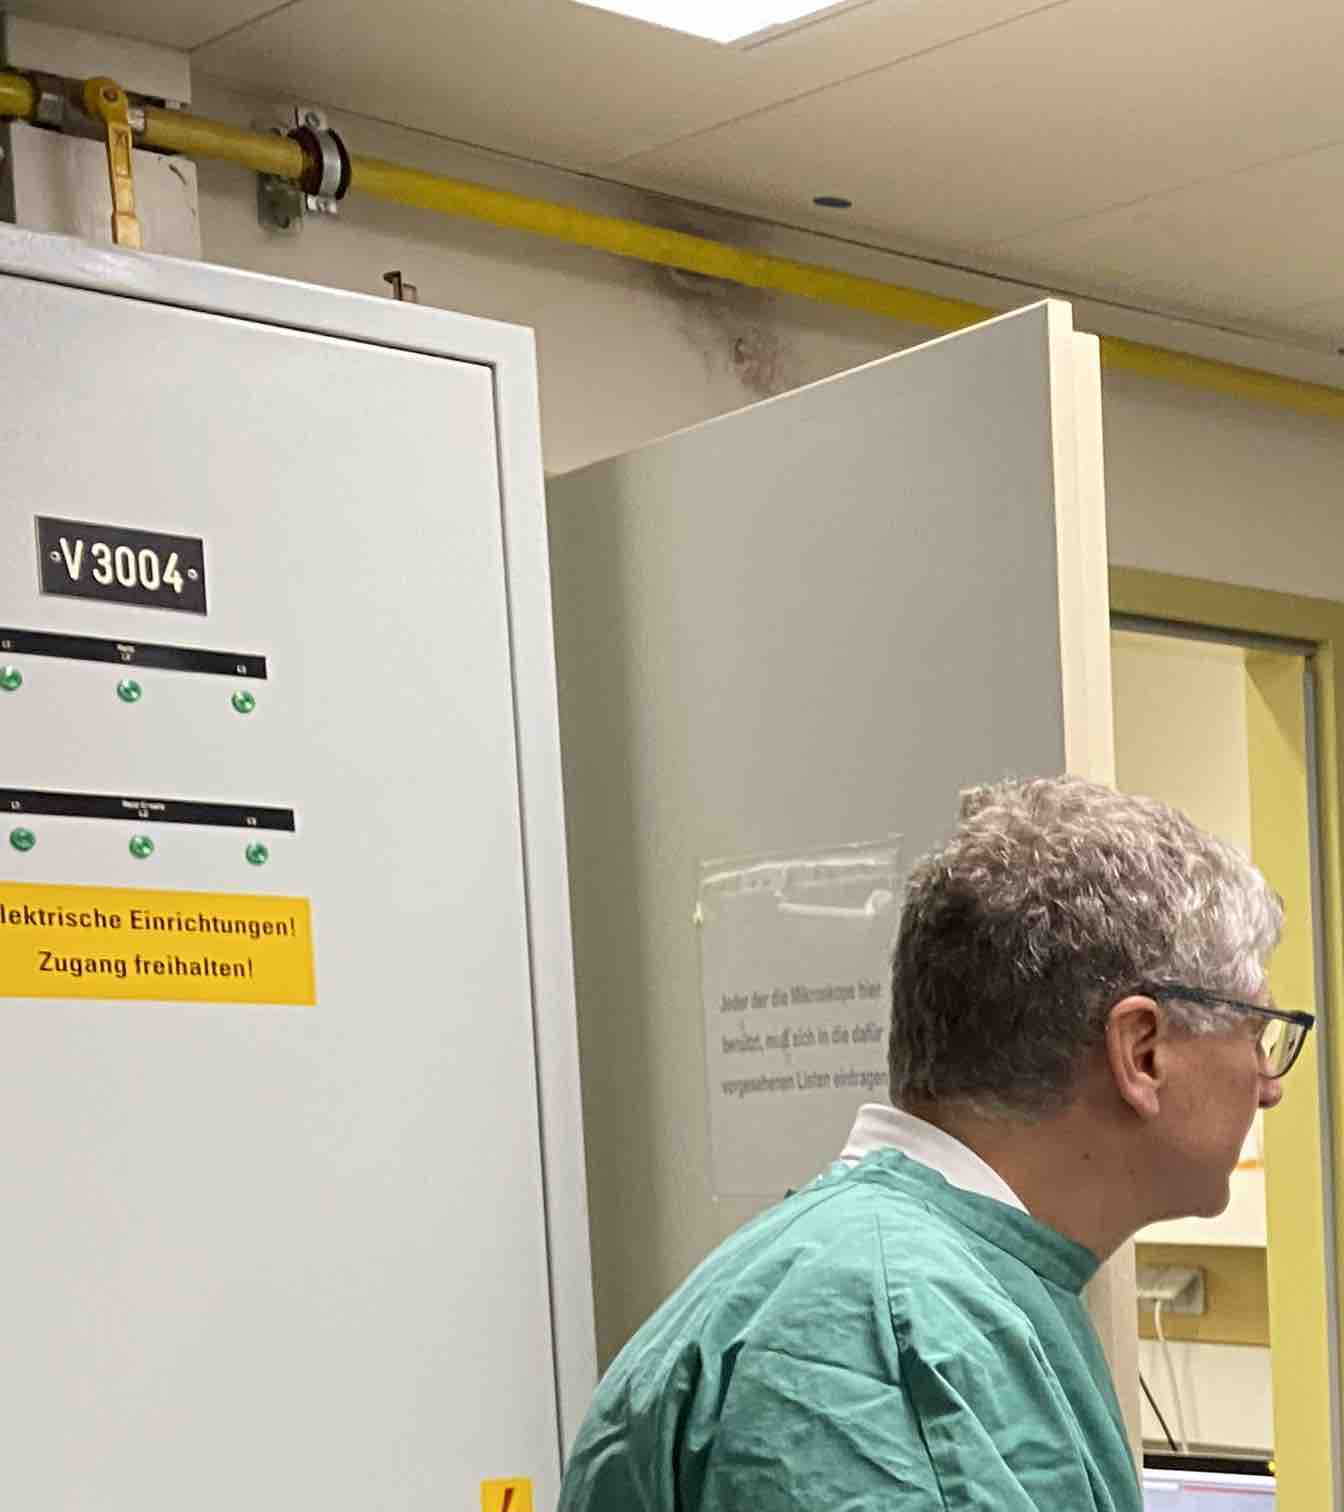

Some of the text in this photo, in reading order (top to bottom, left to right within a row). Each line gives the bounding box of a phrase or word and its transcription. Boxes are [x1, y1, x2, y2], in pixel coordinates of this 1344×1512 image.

[0, 905, 297, 939] lektrische Einrichtungen!
[38, 950, 254, 978] Zugang freihalten!
